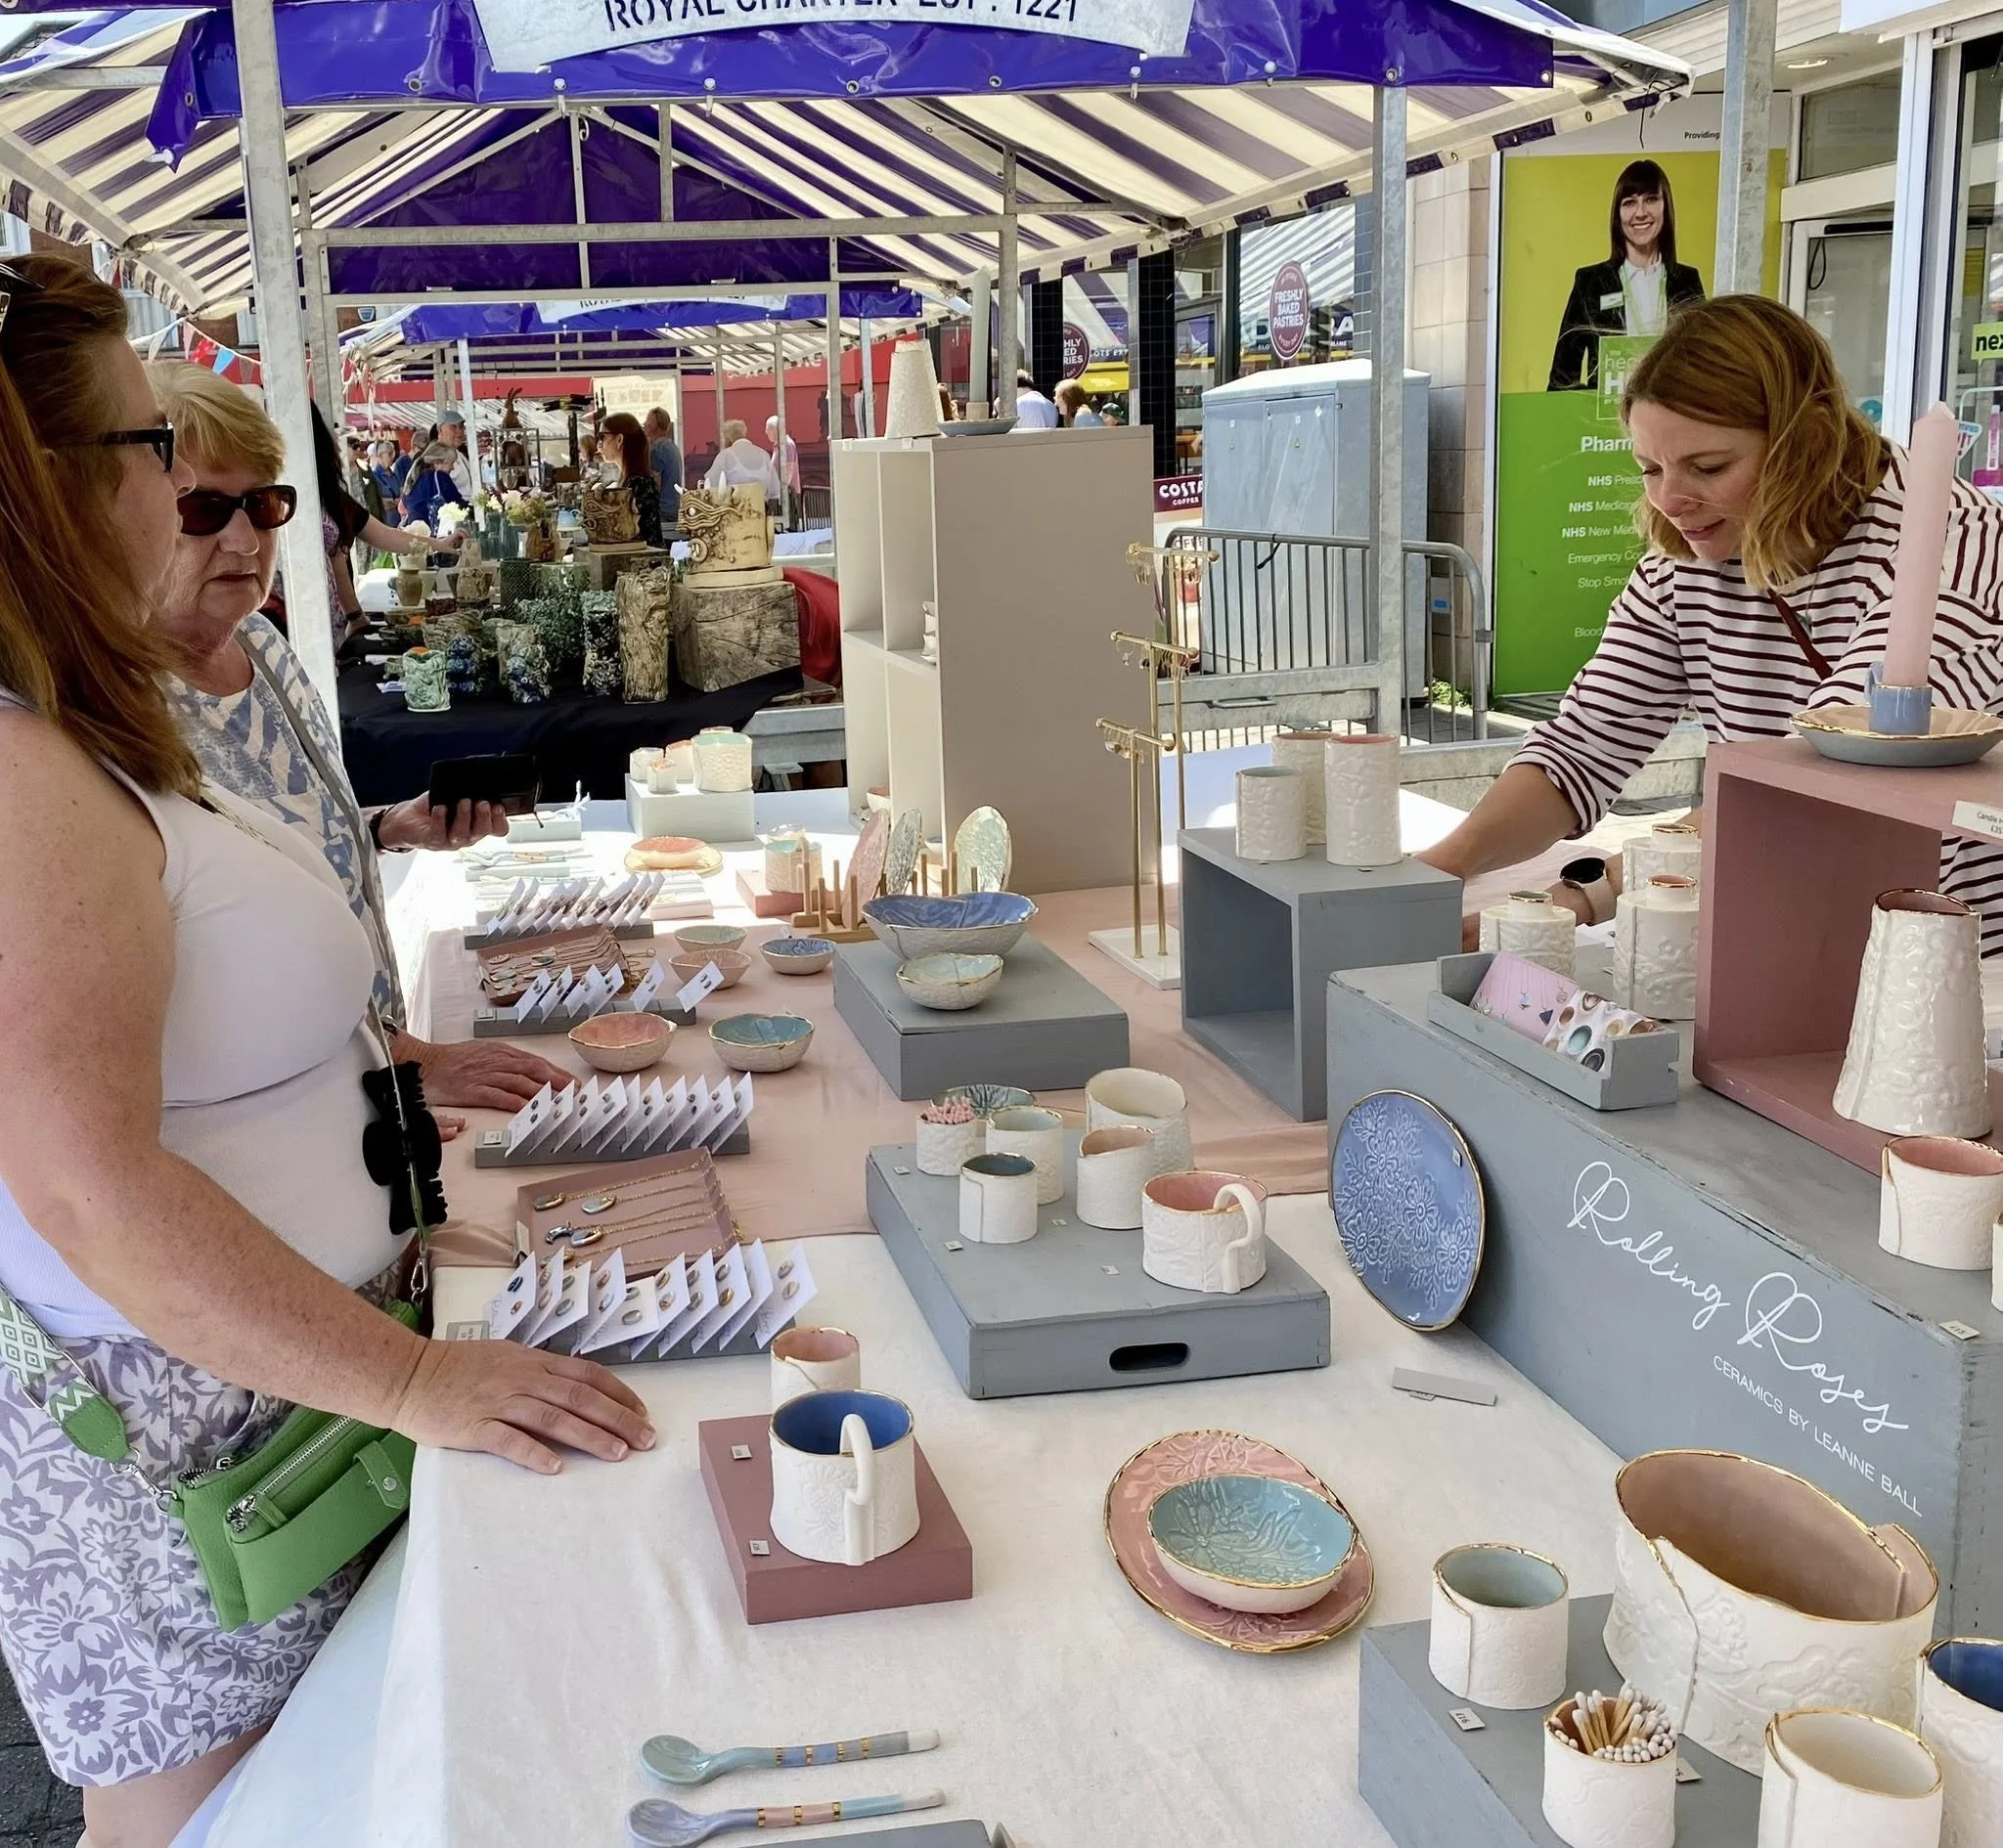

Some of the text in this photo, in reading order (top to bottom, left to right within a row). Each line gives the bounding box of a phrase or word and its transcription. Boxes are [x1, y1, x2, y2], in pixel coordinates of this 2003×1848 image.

[1684, 131, 1720, 141] Providing
[1274, 288, 1304, 303] FRESHLY
[1277, 301, 1301, 316] BAKED
[1272, 313, 1304, 329] PASTRIES
[1588, 475, 1613, 486] NHS
[1173, 497, 1199, 506] COFFEE
[1569, 501, 1594, 512] NHS
[1562, 527, 1586, 538] NHS
[1588, 526, 1611, 537] New
[1568, 551, 1621, 564] Emergency
[1579, 577, 1601, 589] Stop
[1977, 811, 1997, 823] Candle
[1567, 1161, 1909, 1433] Rolling Roses
[1714, 1355, 1923, 1518] CERAMICS BY LEANNE BALL
